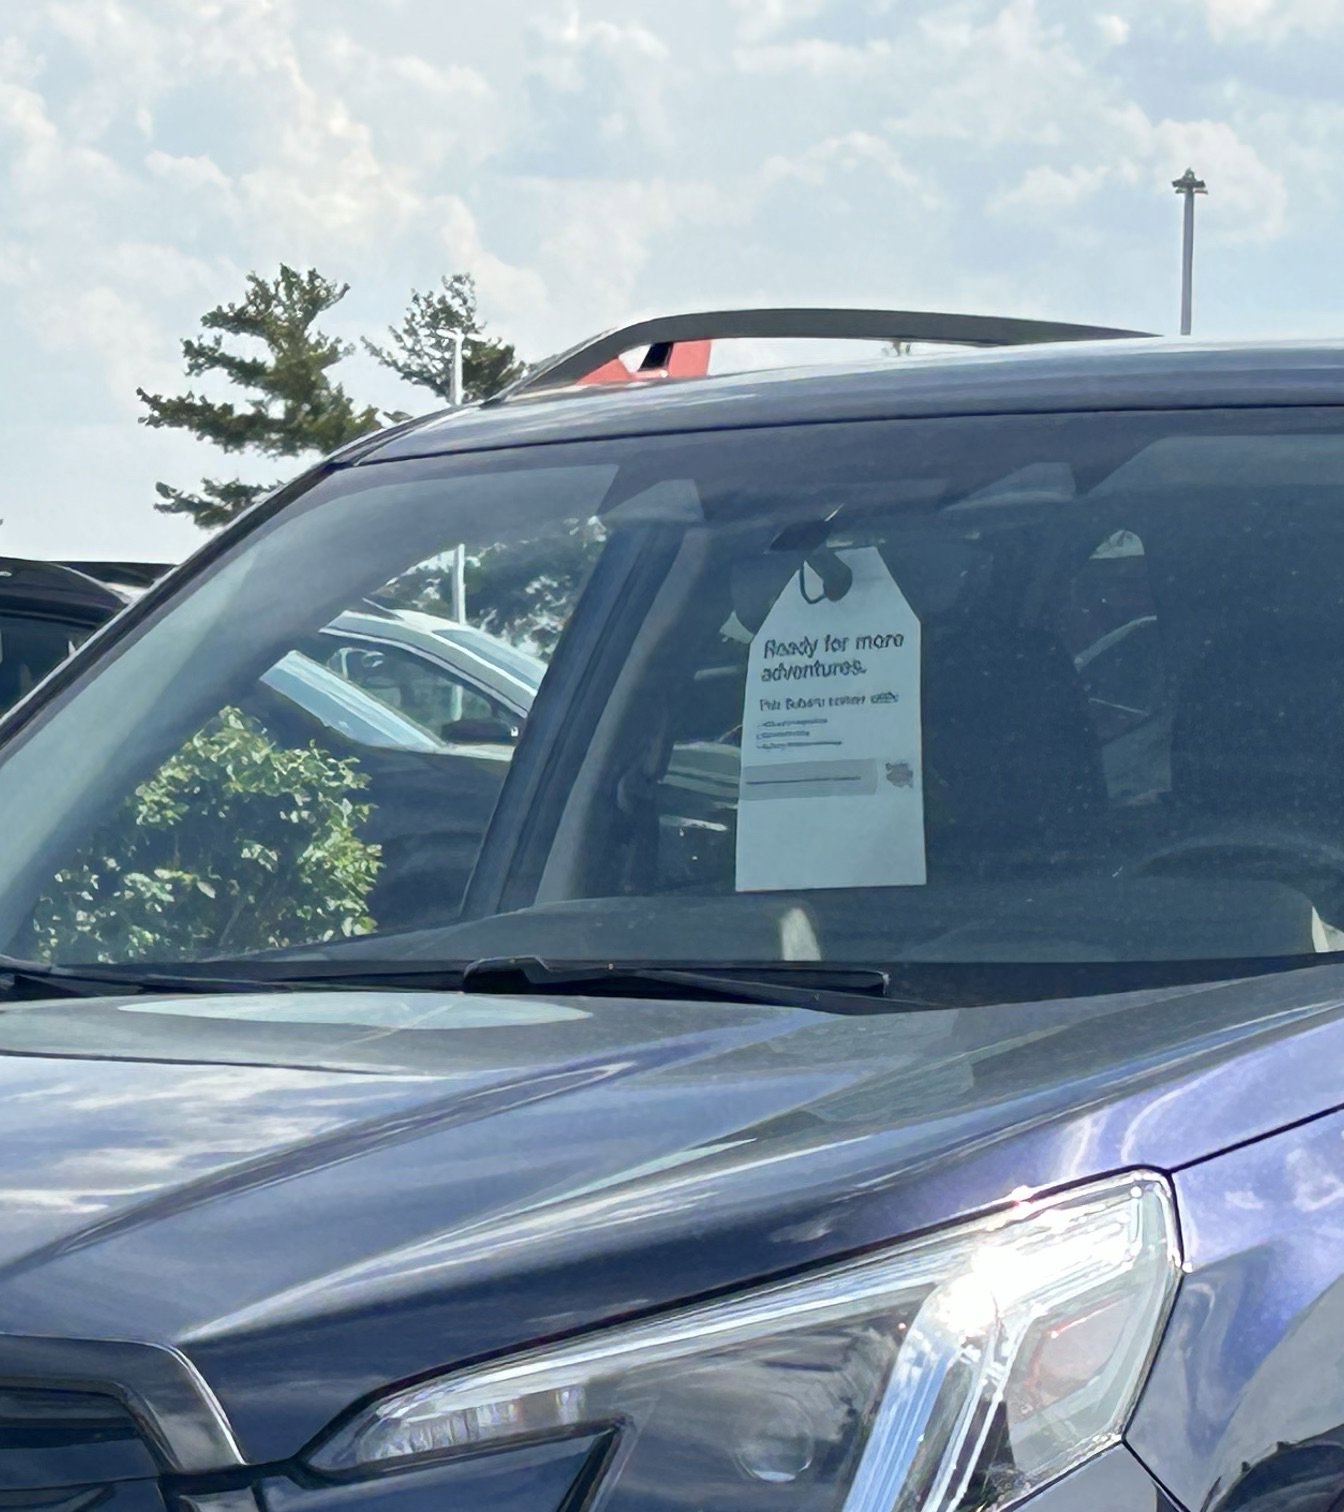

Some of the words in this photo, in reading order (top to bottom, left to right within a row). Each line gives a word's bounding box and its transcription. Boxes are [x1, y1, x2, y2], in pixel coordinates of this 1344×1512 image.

[763, 635, 819, 659] Ready
[824, 634, 850, 653] for
[855, 633, 905, 650] more
[760, 659, 867, 683] adventures.
